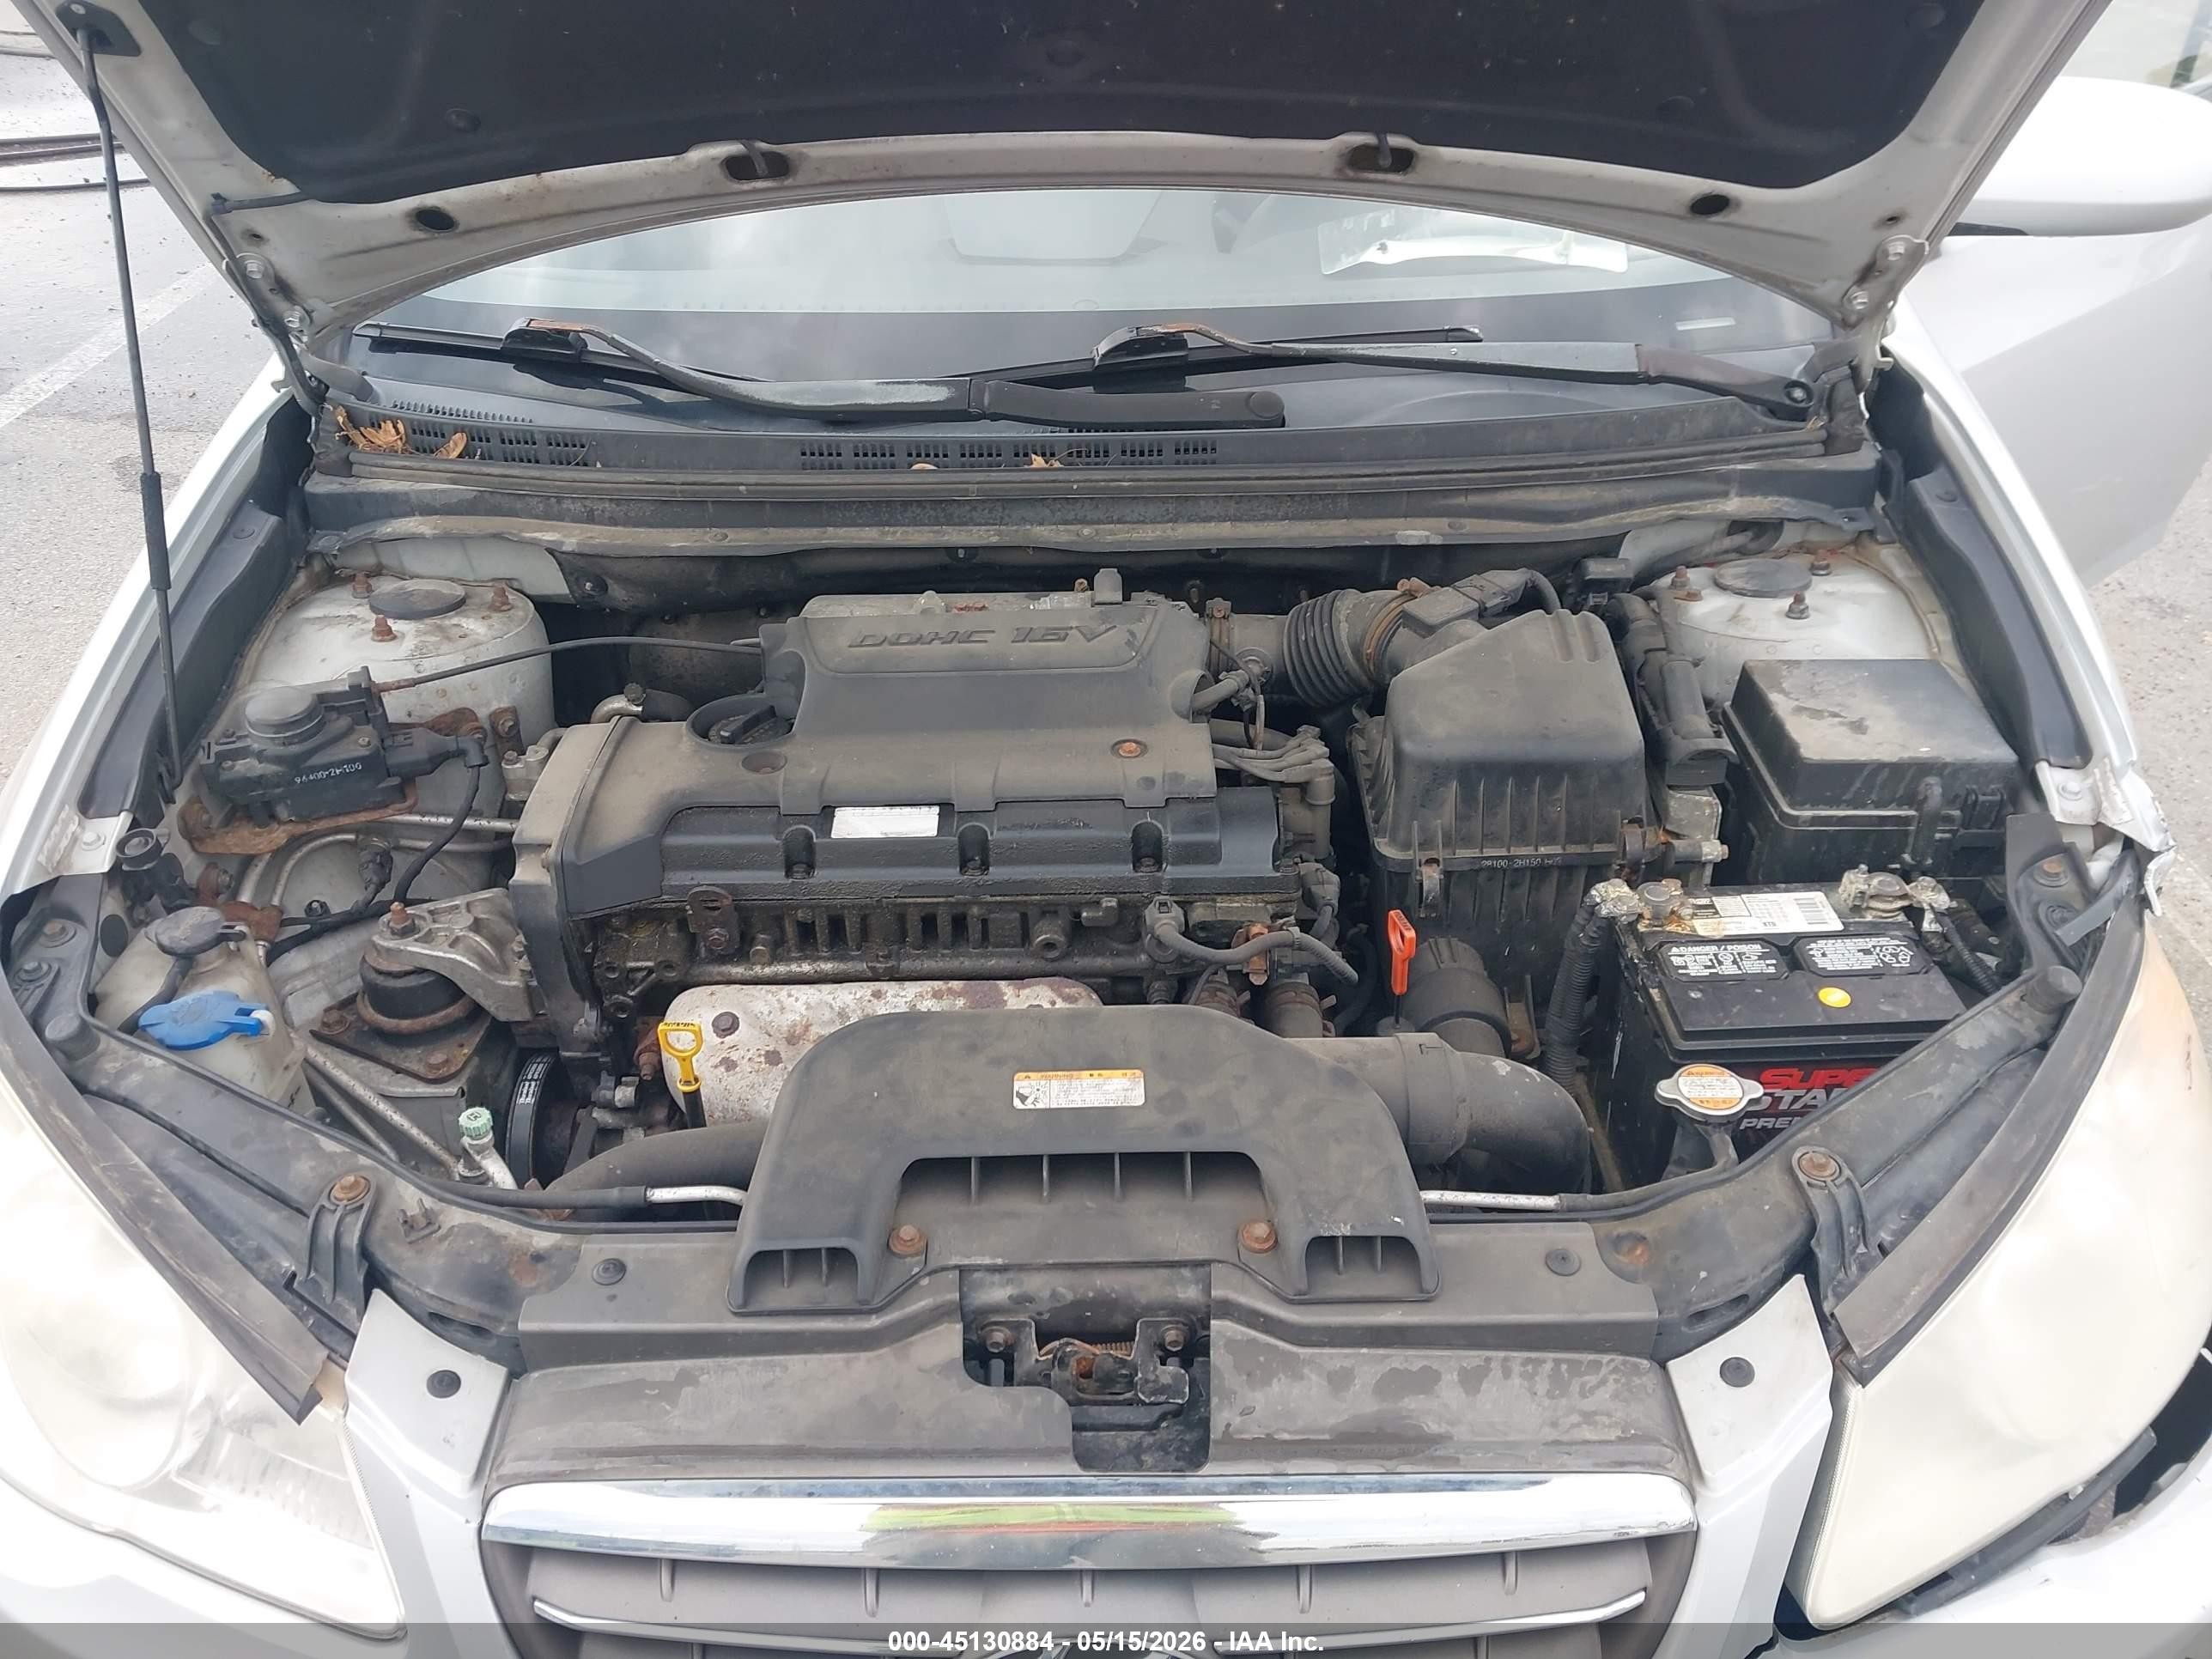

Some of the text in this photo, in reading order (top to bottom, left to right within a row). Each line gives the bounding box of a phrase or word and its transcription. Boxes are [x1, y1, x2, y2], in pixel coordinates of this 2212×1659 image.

[848, 624, 1118, 647] DOHC 16V
[1759, 1067, 1878, 1089] SUPE
